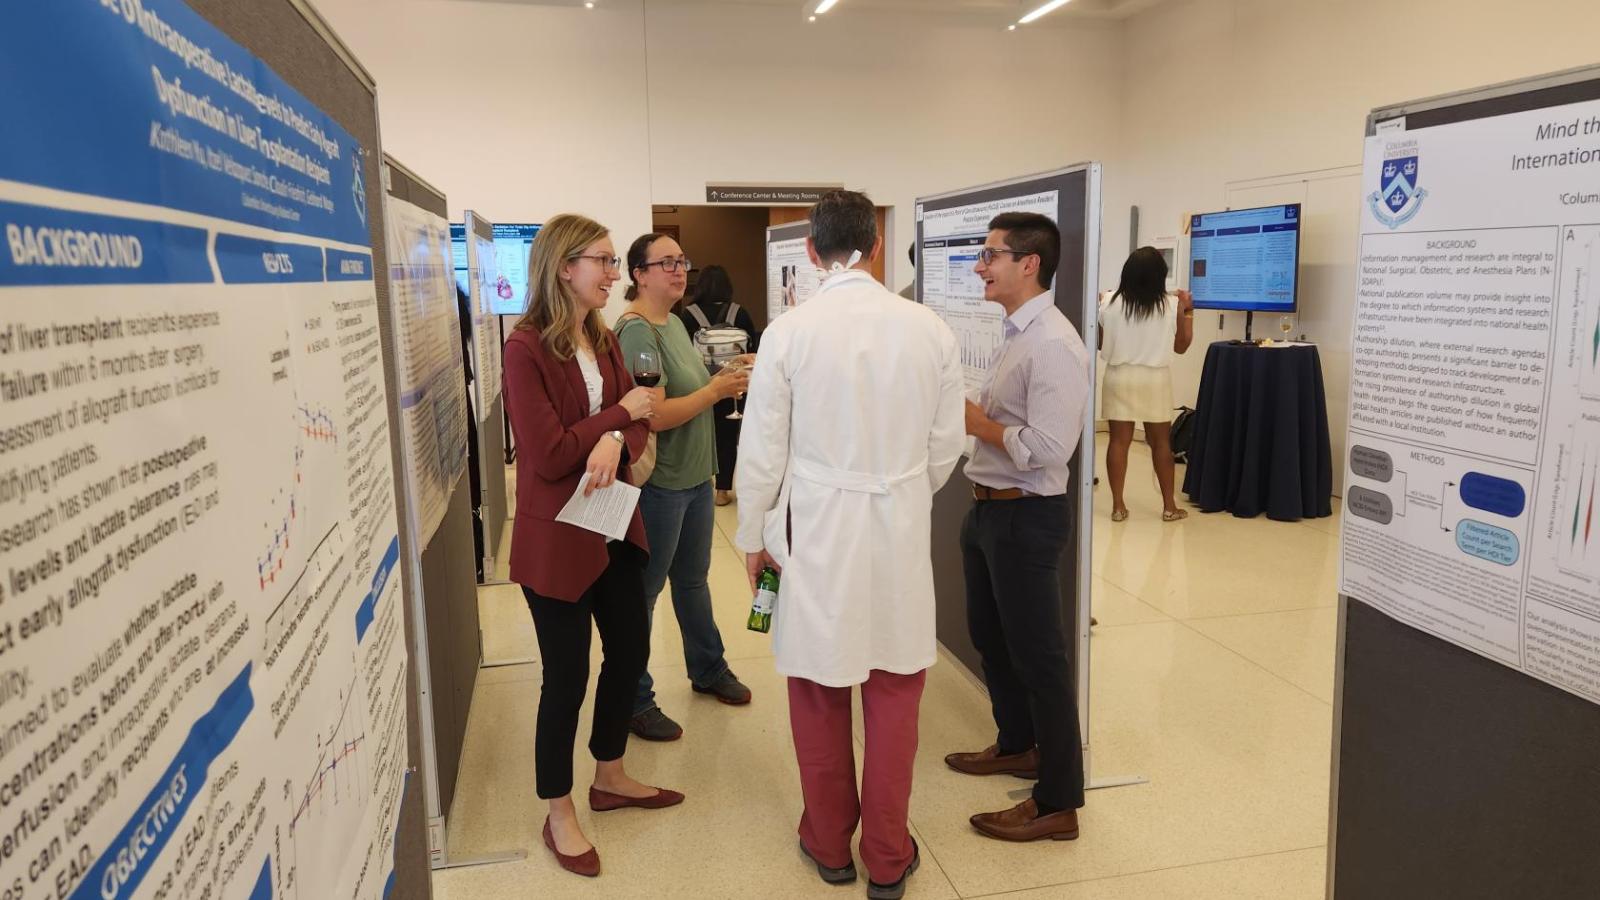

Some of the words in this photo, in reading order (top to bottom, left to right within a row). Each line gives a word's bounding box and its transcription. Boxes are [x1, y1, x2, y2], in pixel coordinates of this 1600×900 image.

[1536, 118, 1579, 141] Mind
[1512, 147, 1600, 170] Internation
[778, 192, 799, 200] Meeting
[7, 223, 142, 268] BACKGROUND
[1426, 240, 1477, 249] BACKGROUND
[1566, 229, 1576, 241] A
[1401, 255, 1447, 264] management
[1449, 253, 1463, 262] and
[1512, 252, 1543, 263] integral
[1545, 252, 1554, 262] to
[1456, 266, 1470, 274] and
[1472, 265, 1513, 275] Anesthesia
[1516, 265, 1537, 275] Plans
[1386, 290, 1424, 300] publication
[1427, 292, 1453, 300] volume
[1456, 293, 1471, 302] may
[1474, 292, 1501, 301] provide
[1504, 293, 1531, 304] insight
[1534, 293, 1552, 303] into
[1402, 303, 1422, 311] which
[1424, 304, 1466, 312] information
[1467, 306, 1497, 316] systems
[1499, 307, 1513, 316] and
[1516, 309, 1550, 317] research
[16, 322, 50, 352] liver
[51, 316, 124, 347] transplant
[1434, 316, 1472, 328] integrated
[1473, 319, 1489, 328] into
[1490, 320, 1521, 330] national
[1523, 321, 1549, 331] health
[1412, 352, 1441, 362] presents
[1450, 354, 1490, 366] significant
[1491, 359, 1518, 370] barrier
[1520, 362, 1529, 372] to
[1420, 341, 1441, 350] where
[1443, 343, 1474, 352] external
[1477, 345, 1509, 355] research
[1512, 348, 1546, 360] agendas
[0, 369, 48, 402] failure
[51, 359, 88, 389] within
[89, 355, 99, 381] 6
[101, 350, 146, 377] months
[148, 345, 169, 369] after
[1380, 360, 1407, 371] methods
[1408, 363, 1440, 375] designed
[1450, 367, 1467, 377] track
[1469, 370, 1521, 383] development
[1522, 376, 1531, 385] of
[1383, 371, 1407, 382] systems
[1408, 374, 1421, 385] and
[1422, 377, 1451, 388] research
[65, 400, 79, 429] of
[81, 387, 129, 425] allograft
[130, 384, 172, 409] function
[1372, 393, 1397, 405] research
[1399, 398, 1415, 408] begs
[1417, 401, 1429, 410] the
[1431, 403, 1463, 416] question
[1465, 407, 1475, 417] of
[1476, 409, 1494, 421] how
[1496, 411, 1539, 431] frequently
[1382, 384, 1418, 396] prevalence
[1428, 391, 1469, 404] authorship
[1470, 396, 1501, 408] dilution
[1513, 402, 1541, 414] global
[1414, 412, 1425, 421] are
[1427, 414, 1463, 429] published
[1465, 421, 1495, 434] without
[1497, 427, 1508, 436] an
[1509, 429, 1538, 442] author
[50, 443, 99, 487] patients.
[1410, 451, 1446, 467] METHODS
[58, 496, 81, 521] has
[82, 476, 118, 508] shown
[119, 463, 140, 489] that
[9, 548, 62, 597] levels
[66, 528, 89, 565] and
[90, 508, 127, 547] lactate
[128, 481, 181, 522] clearance
[19, 595, 63, 640] early
[68, 552, 116, 609] allograft
[116, 516, 178, 571] dysfunction
[51, 688, 69, 713] to
[71, 638, 122, 696] evaluate
[124, 600, 160, 647] whether
[162, 573, 197, 609] lactate
[0, 705, 98, 806] centrations
[100, 666, 136, 713] before
[138, 643, 153, 675] and
[154, 622, 174, 653] after
[81, 735, 107, 780] and
[169, 636, 200, 673] lactate
[29, 836, 62, 882] can
[65, 769, 119, 844] identify
[121, 707, 168, 780] recipients
[184, 668, 202, 692] are
[185, 815, 206, 858] EAD
